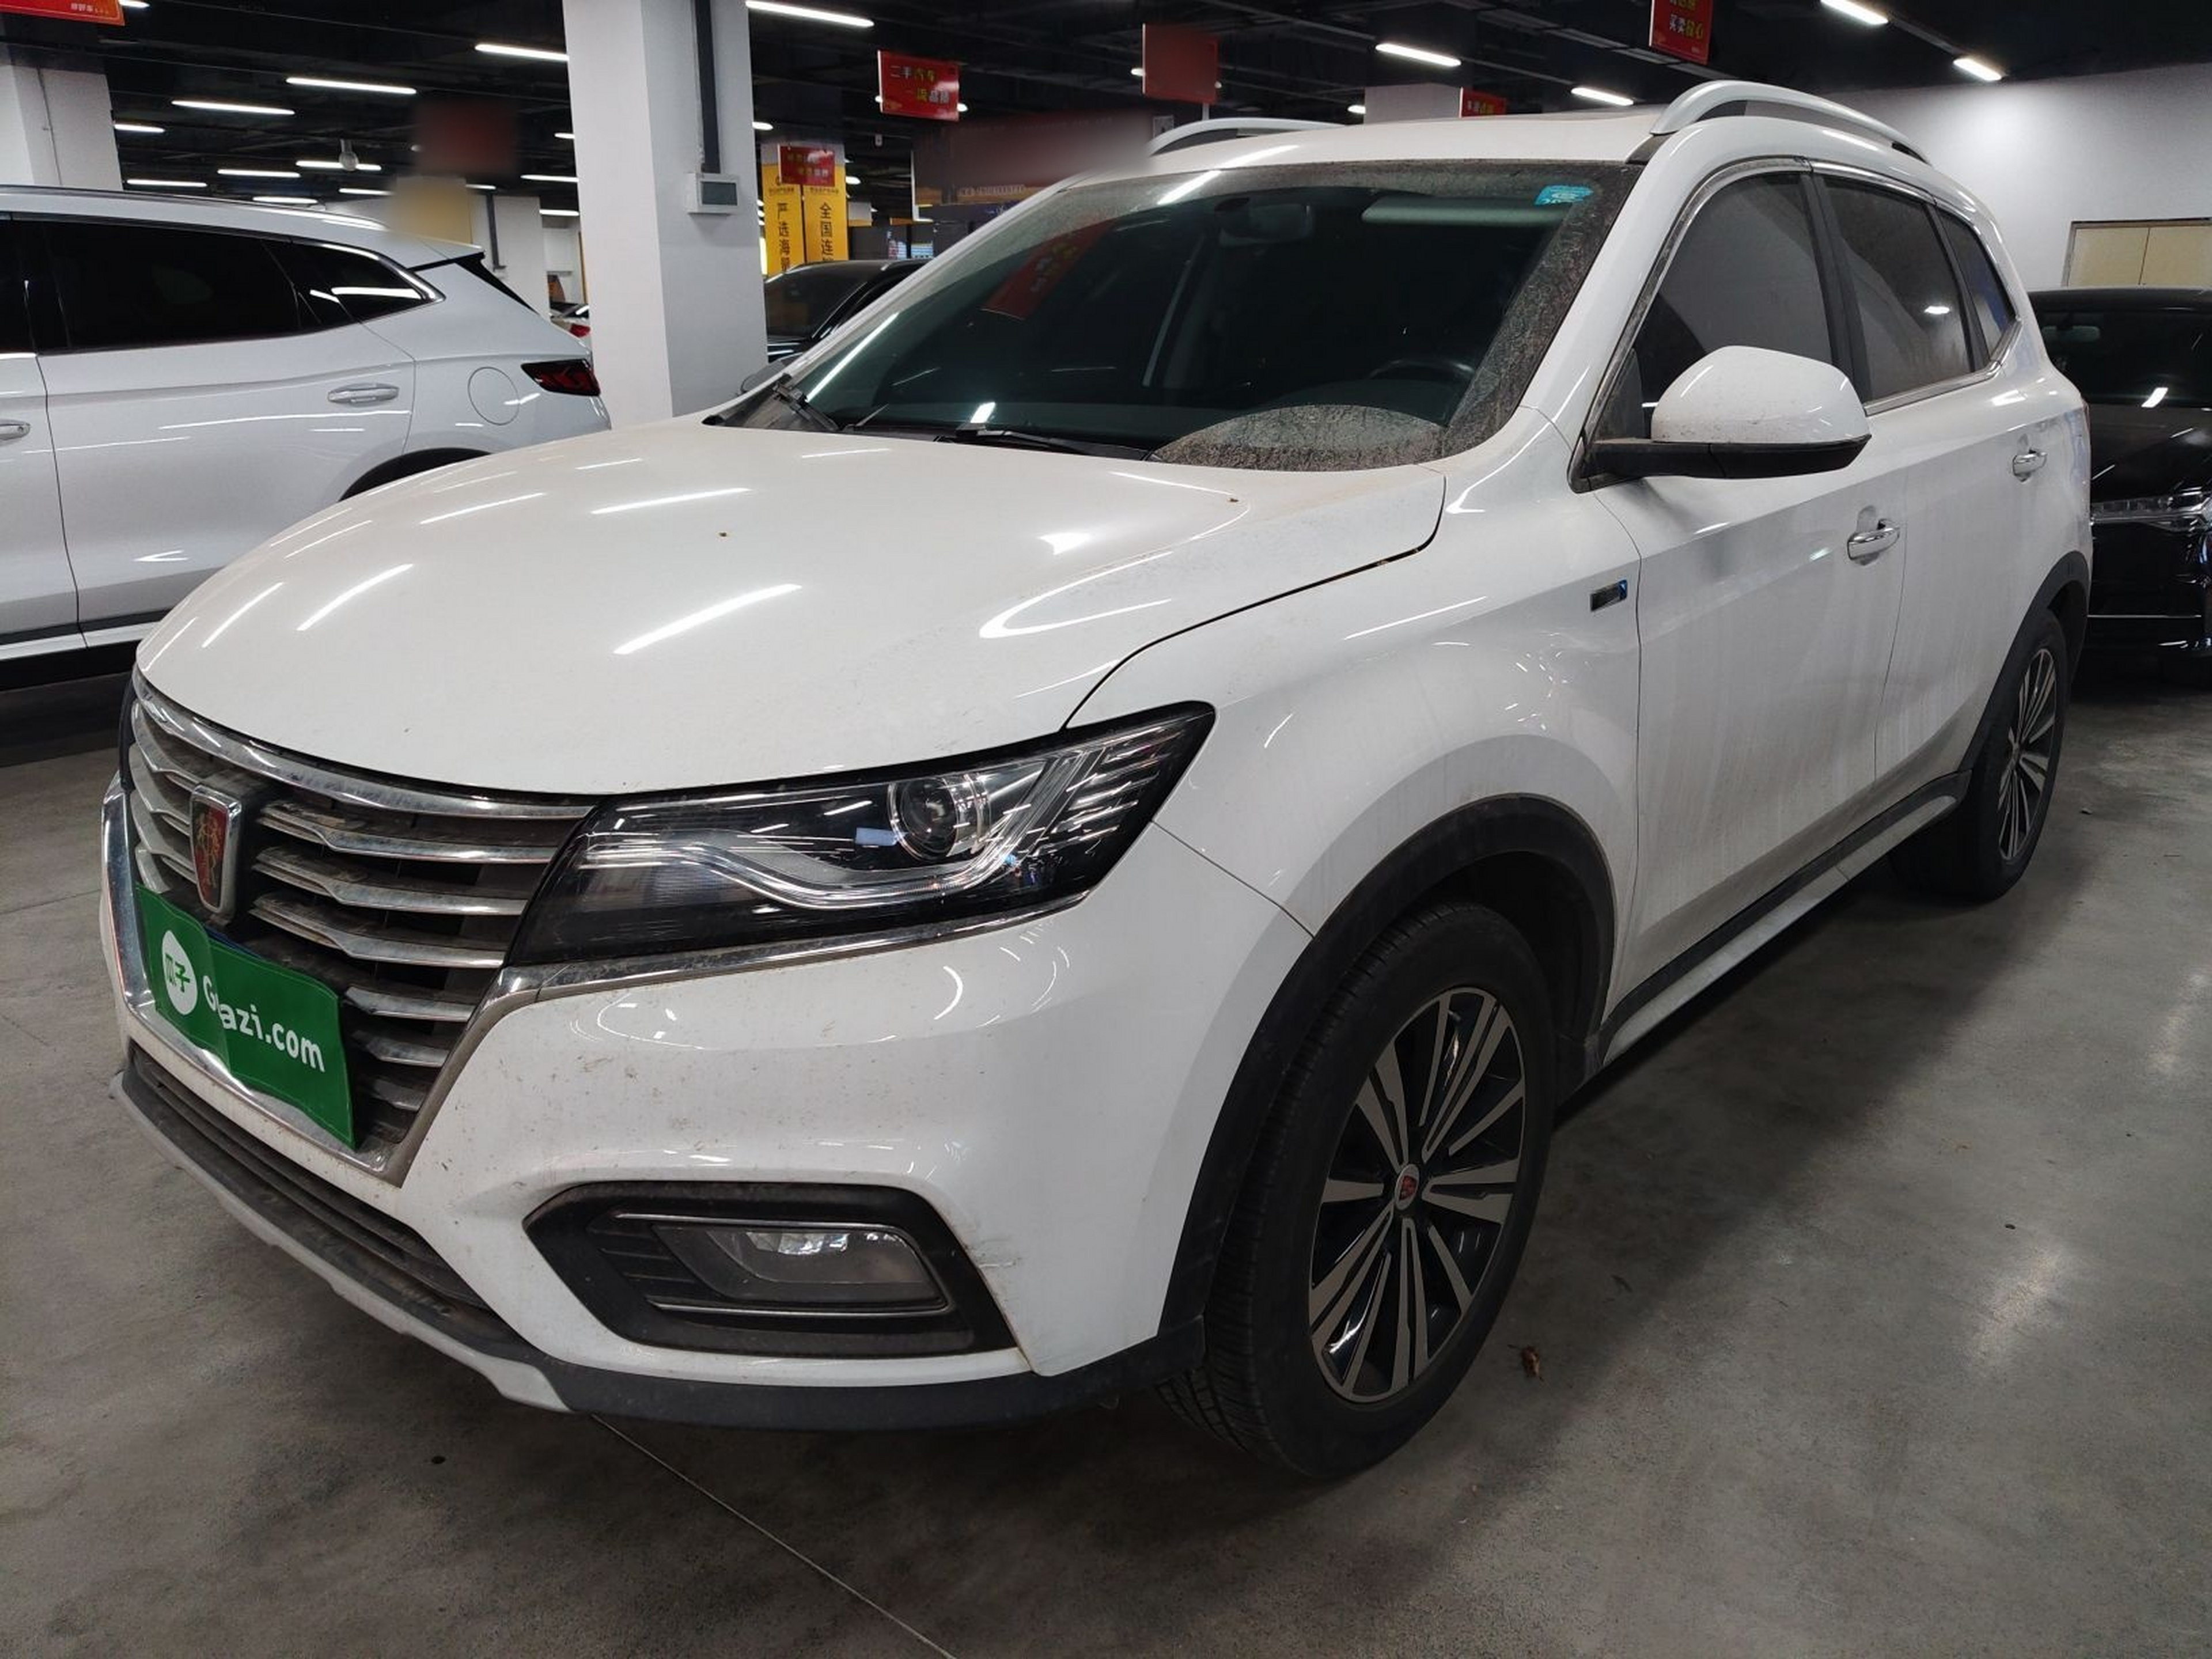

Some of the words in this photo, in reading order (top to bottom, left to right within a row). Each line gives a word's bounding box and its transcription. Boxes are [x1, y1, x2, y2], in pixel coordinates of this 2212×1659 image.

[819, 202, 834, 262] 全国连
[165, 953, 190, 993] 瓜子
